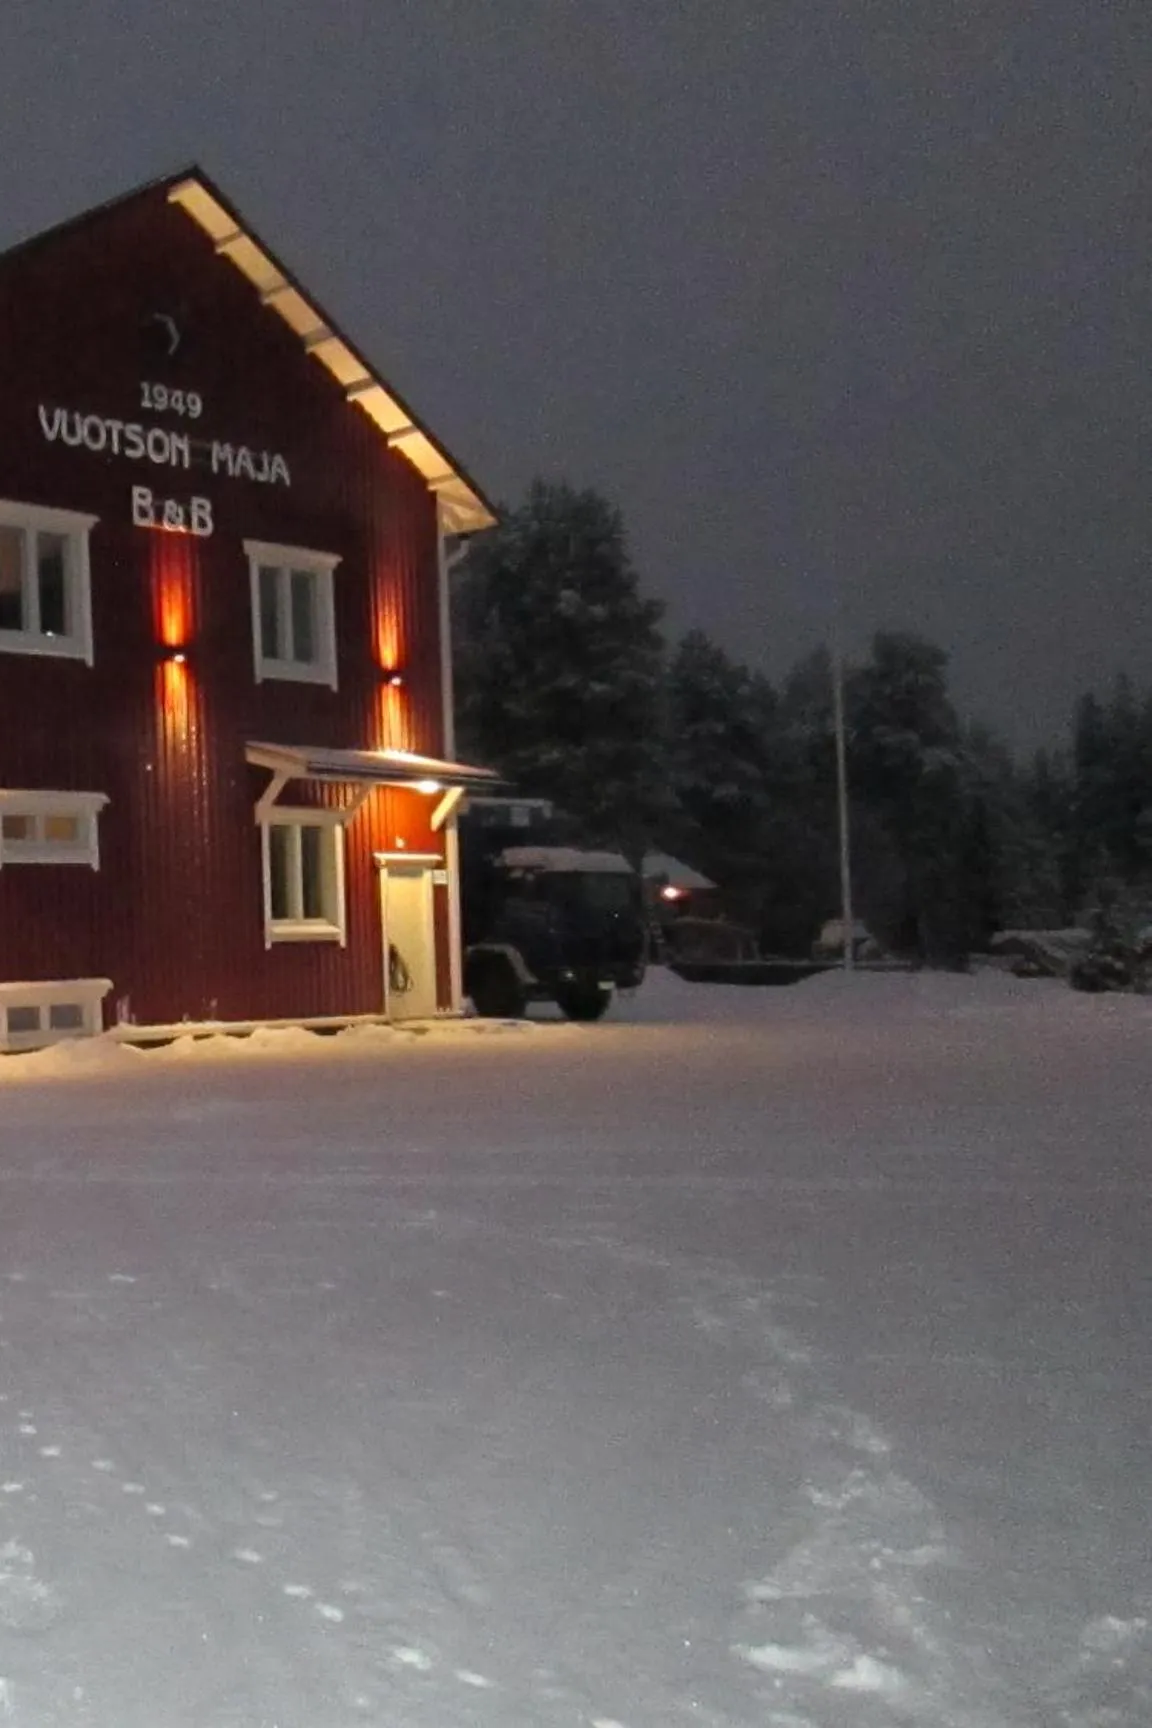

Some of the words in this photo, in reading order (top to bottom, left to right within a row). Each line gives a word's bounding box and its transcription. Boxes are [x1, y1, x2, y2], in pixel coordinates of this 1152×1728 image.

[140, 382, 202, 418] 1949
[38, 405, 190, 468] VUOTSON
[211, 441, 290, 486] MAJA
